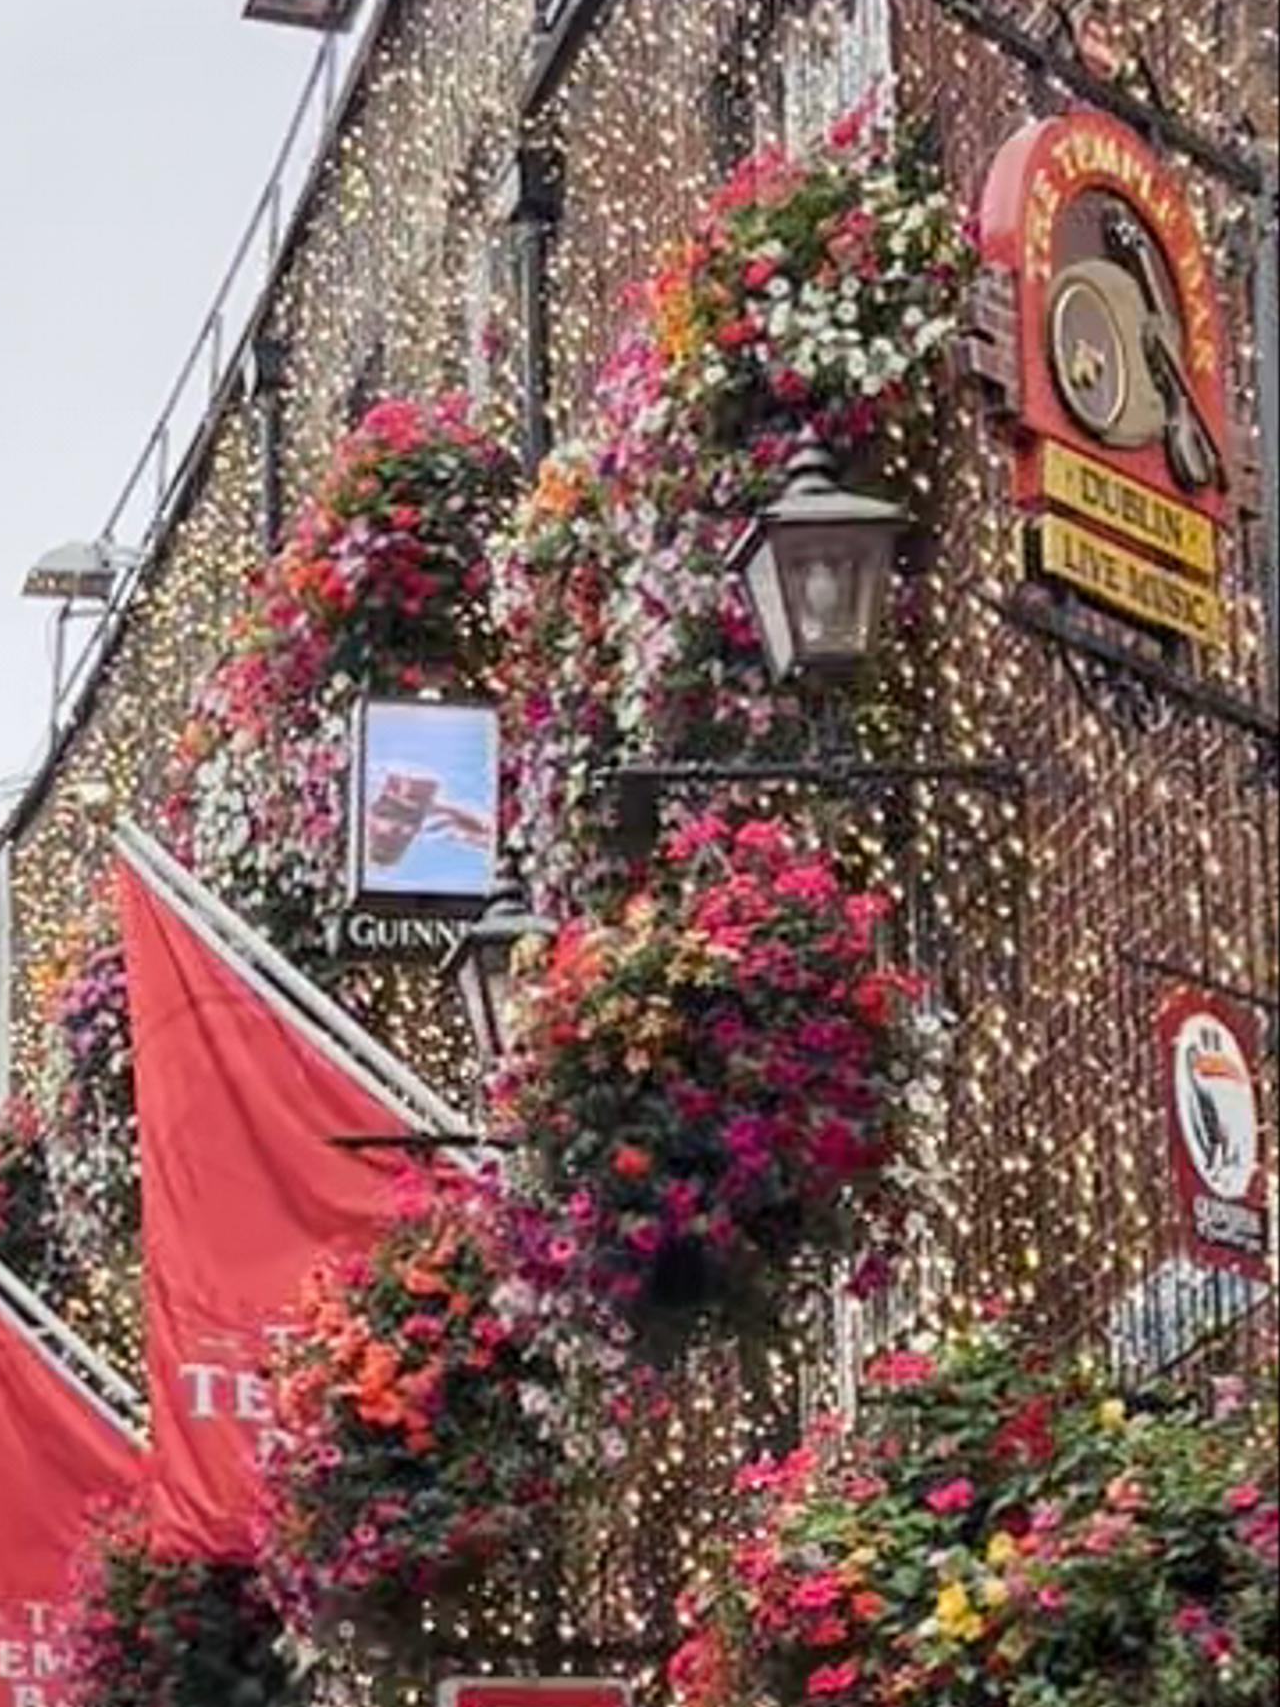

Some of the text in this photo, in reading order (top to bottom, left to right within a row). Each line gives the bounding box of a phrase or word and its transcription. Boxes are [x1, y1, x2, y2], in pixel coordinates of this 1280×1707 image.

[1079, 466, 1184, 548] DUBLIN
[1063, 532, 1208, 631] LIVE MUSIC
